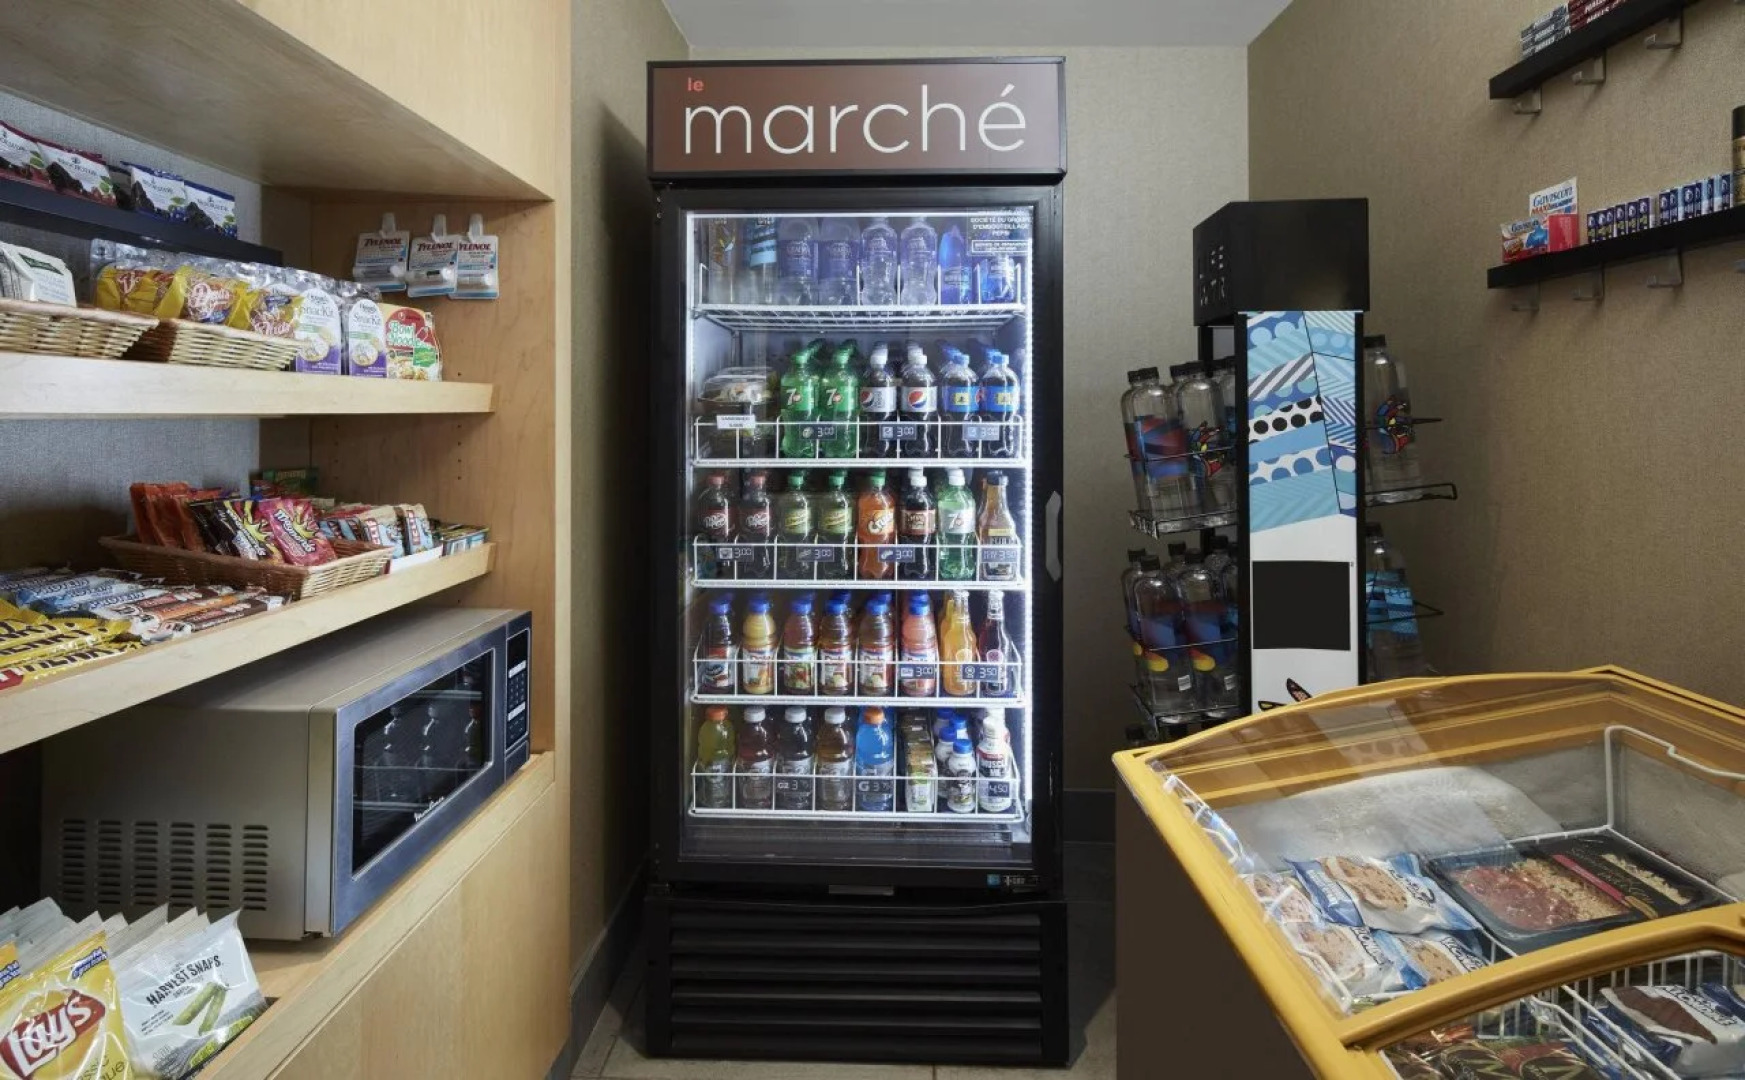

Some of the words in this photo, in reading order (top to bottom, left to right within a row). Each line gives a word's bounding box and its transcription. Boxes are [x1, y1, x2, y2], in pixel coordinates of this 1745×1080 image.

[687, 77, 705, 92] le
[684, 83, 1027, 155] marché
[417, 242, 454, 252] TYLENOL
[459, 243, 491, 251] YLENOL
[145, 969, 190, 1005] HARVEST
[186, 955, 222, 977] SNAPS
